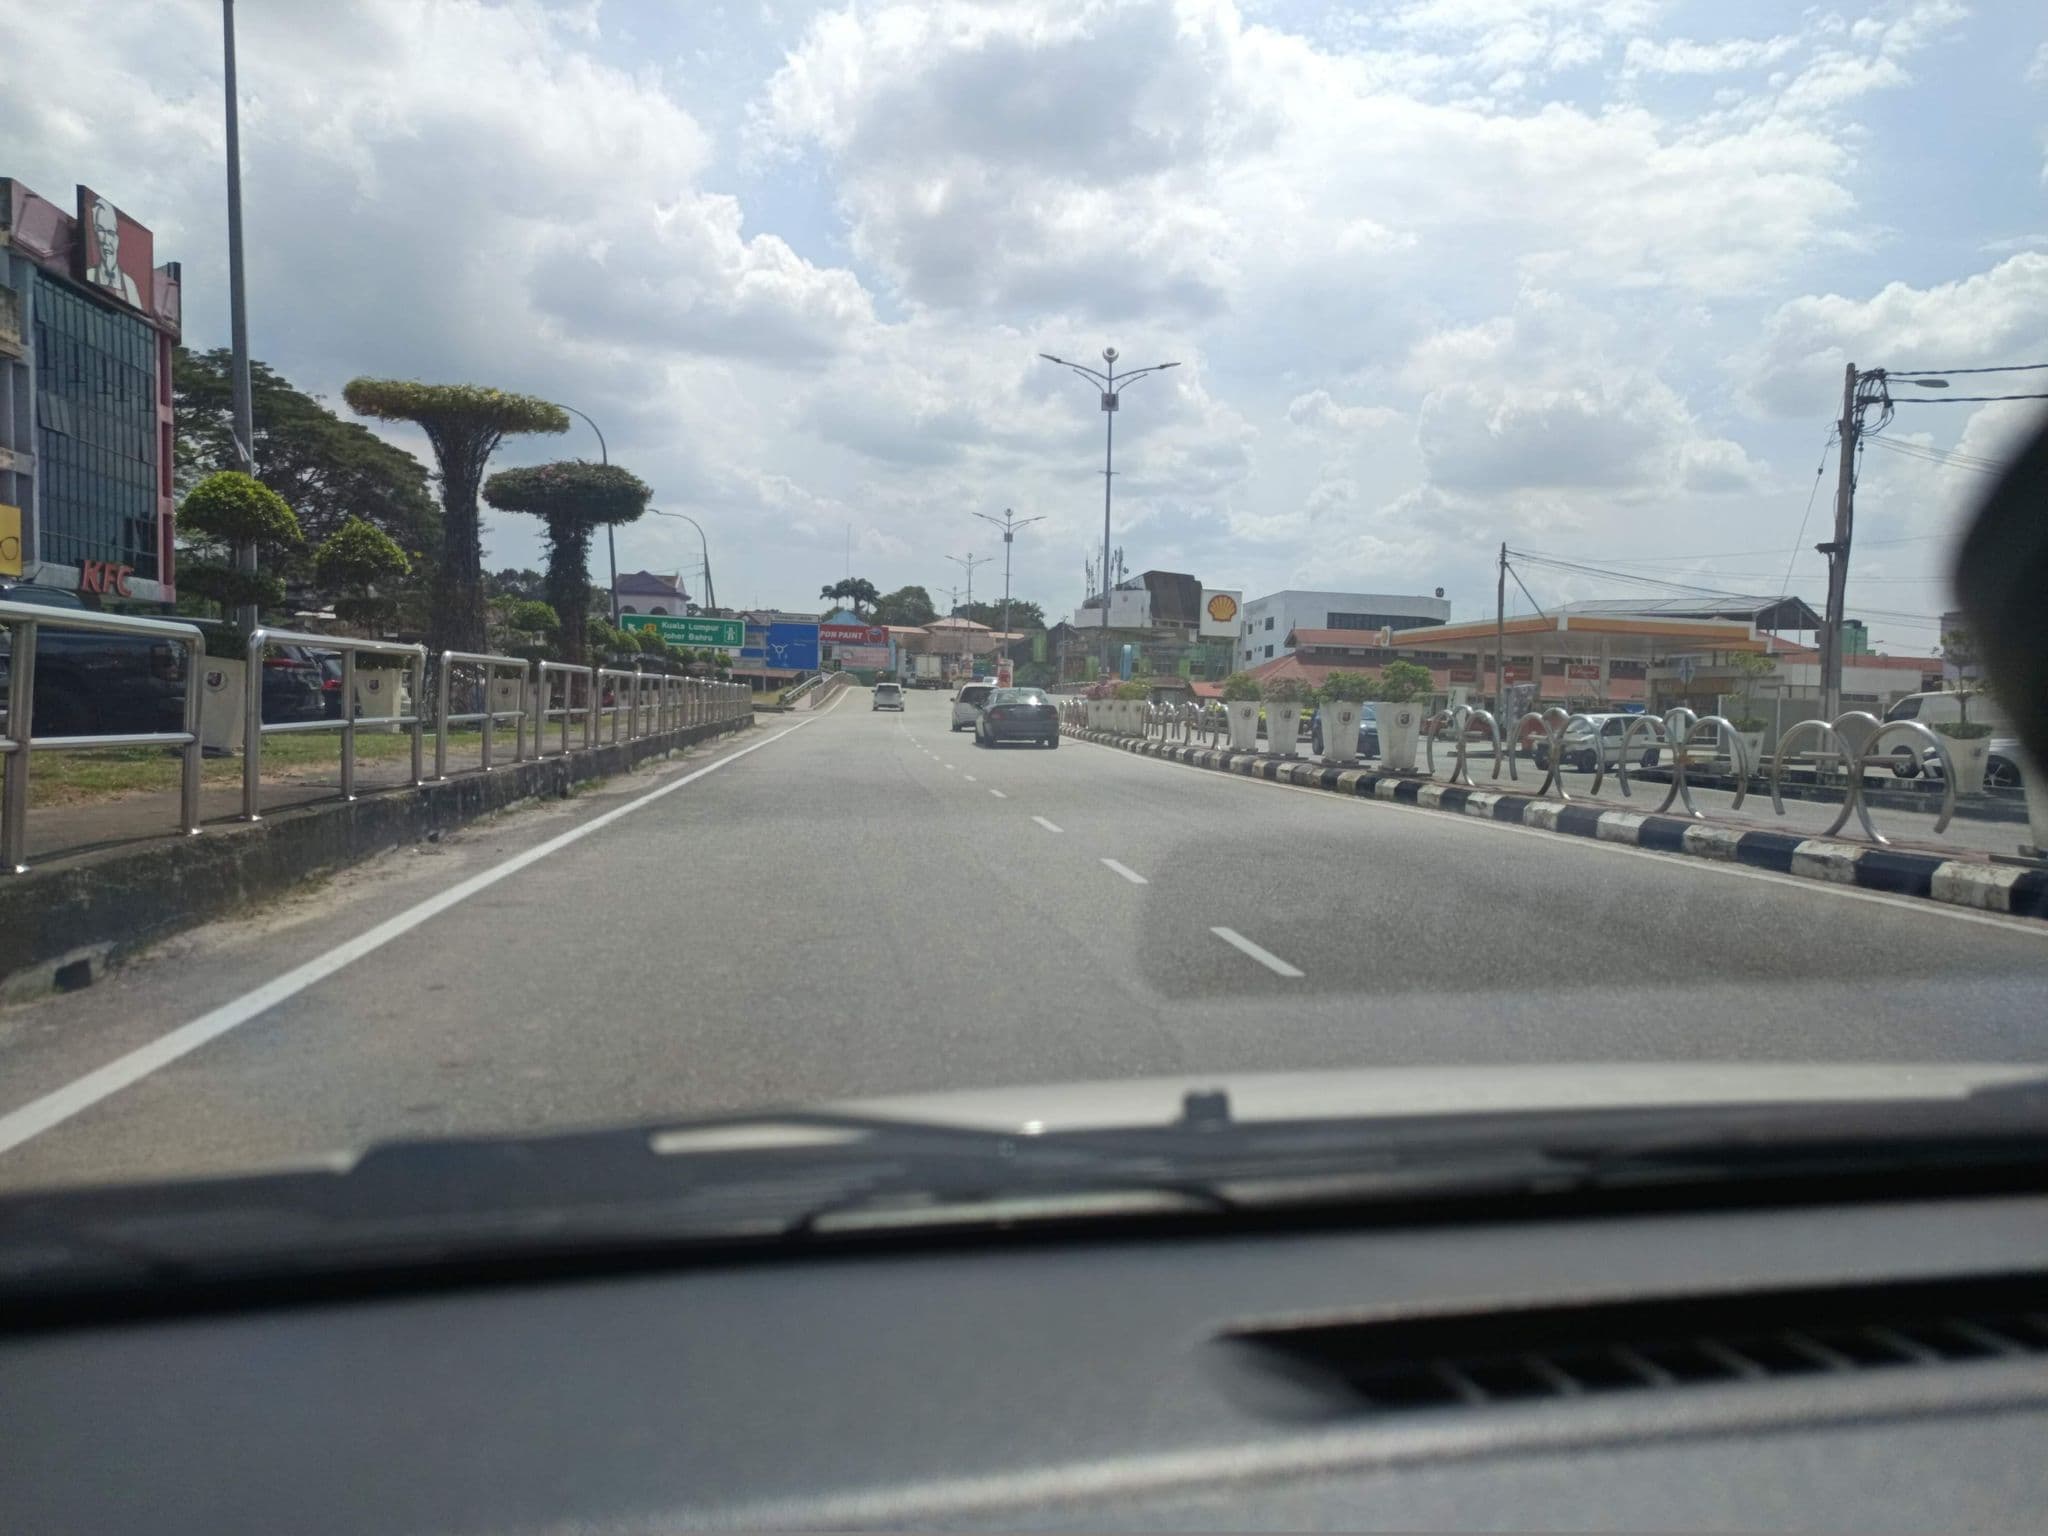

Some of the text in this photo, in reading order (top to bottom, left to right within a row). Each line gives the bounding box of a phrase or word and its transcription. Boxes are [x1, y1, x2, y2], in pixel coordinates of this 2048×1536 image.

[82, 560, 134, 597] KFC
[661, 622, 686, 630] Kuala
[688, 623, 720, 633] Lumpur
[688, 633, 713, 642] Bahru
[838, 632, 863, 640] PAINT
